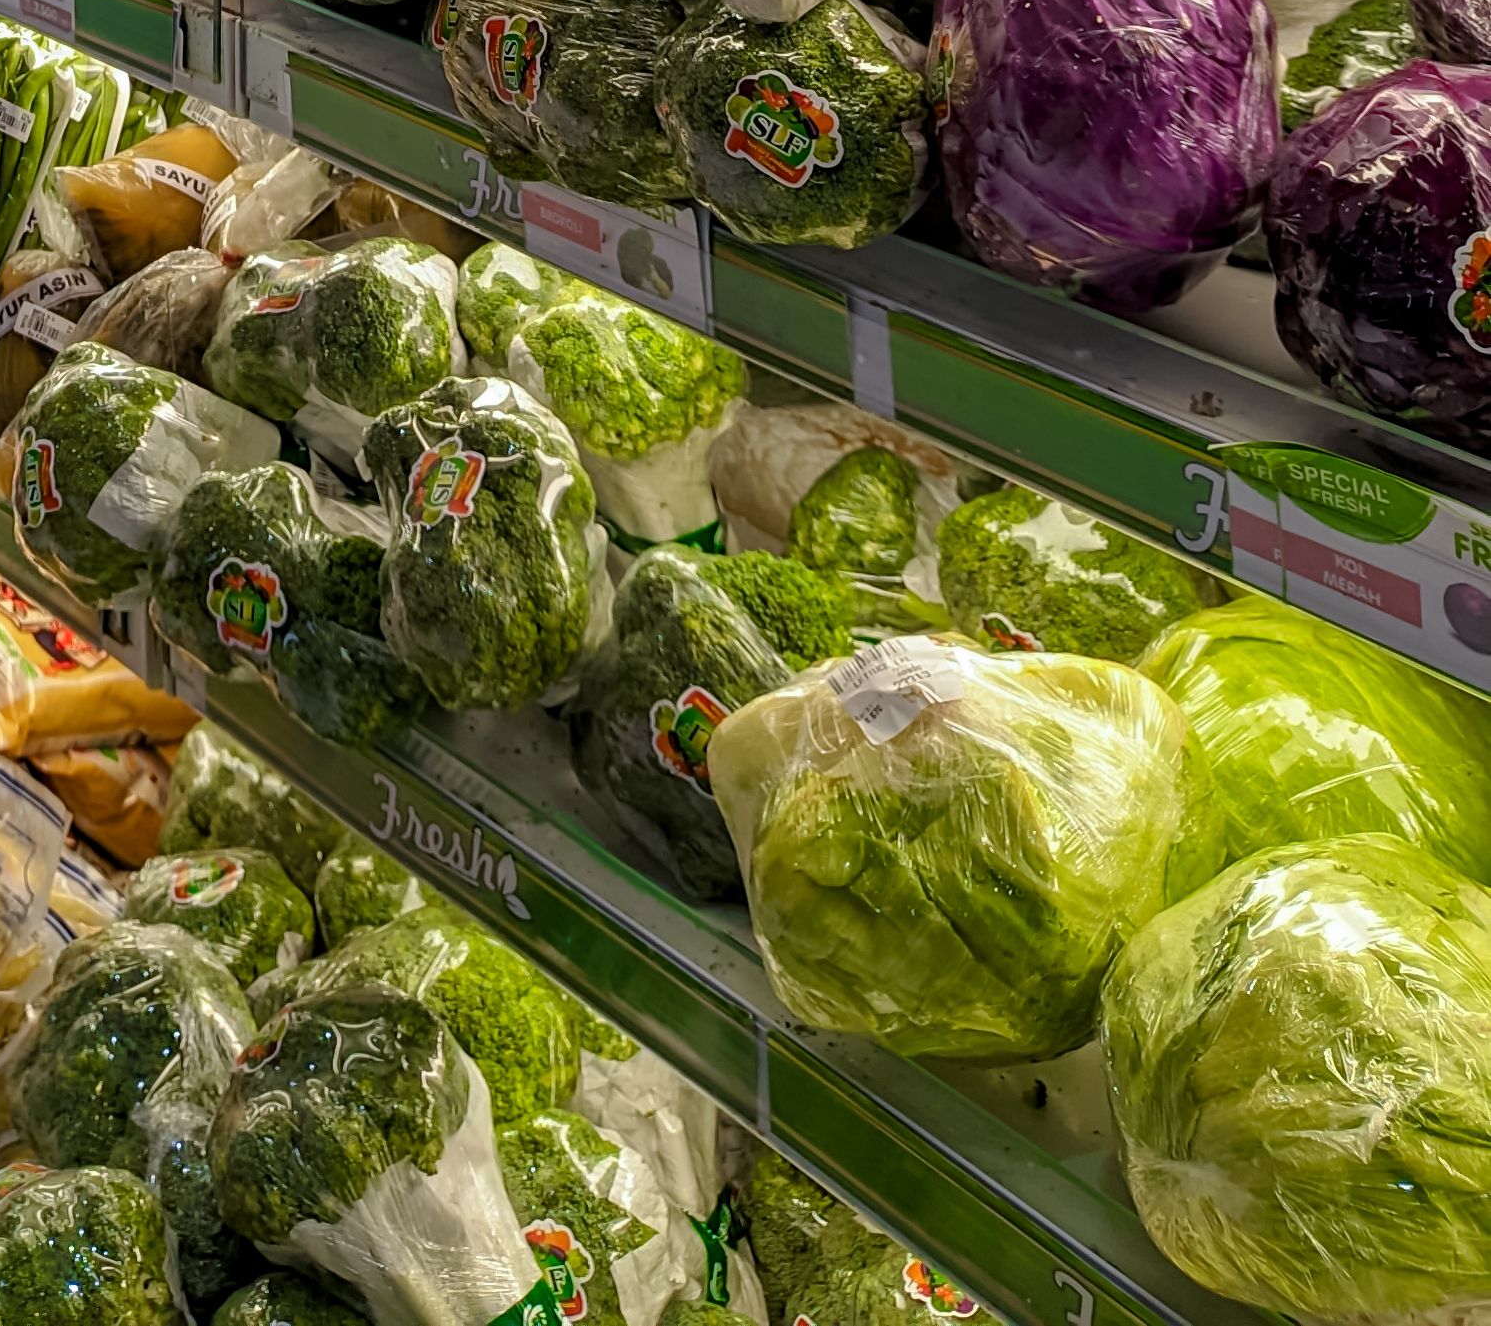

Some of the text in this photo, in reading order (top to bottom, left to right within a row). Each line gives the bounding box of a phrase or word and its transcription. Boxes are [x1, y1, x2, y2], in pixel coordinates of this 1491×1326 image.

[746, 112, 810, 157] SLF
[153, 164, 206, 196] SAYU
[38, 271, 88, 301] ASIN
[432, 460, 460, 508] SLF
[1287, 461, 1391, 505] SPECIAL
[1310, 486, 1372, 518] FRESH
[1333, 551, 1369, 580] KOL
[1322, 570, 1382, 608] MERAH
[369, 772, 501, 891] Fresh
